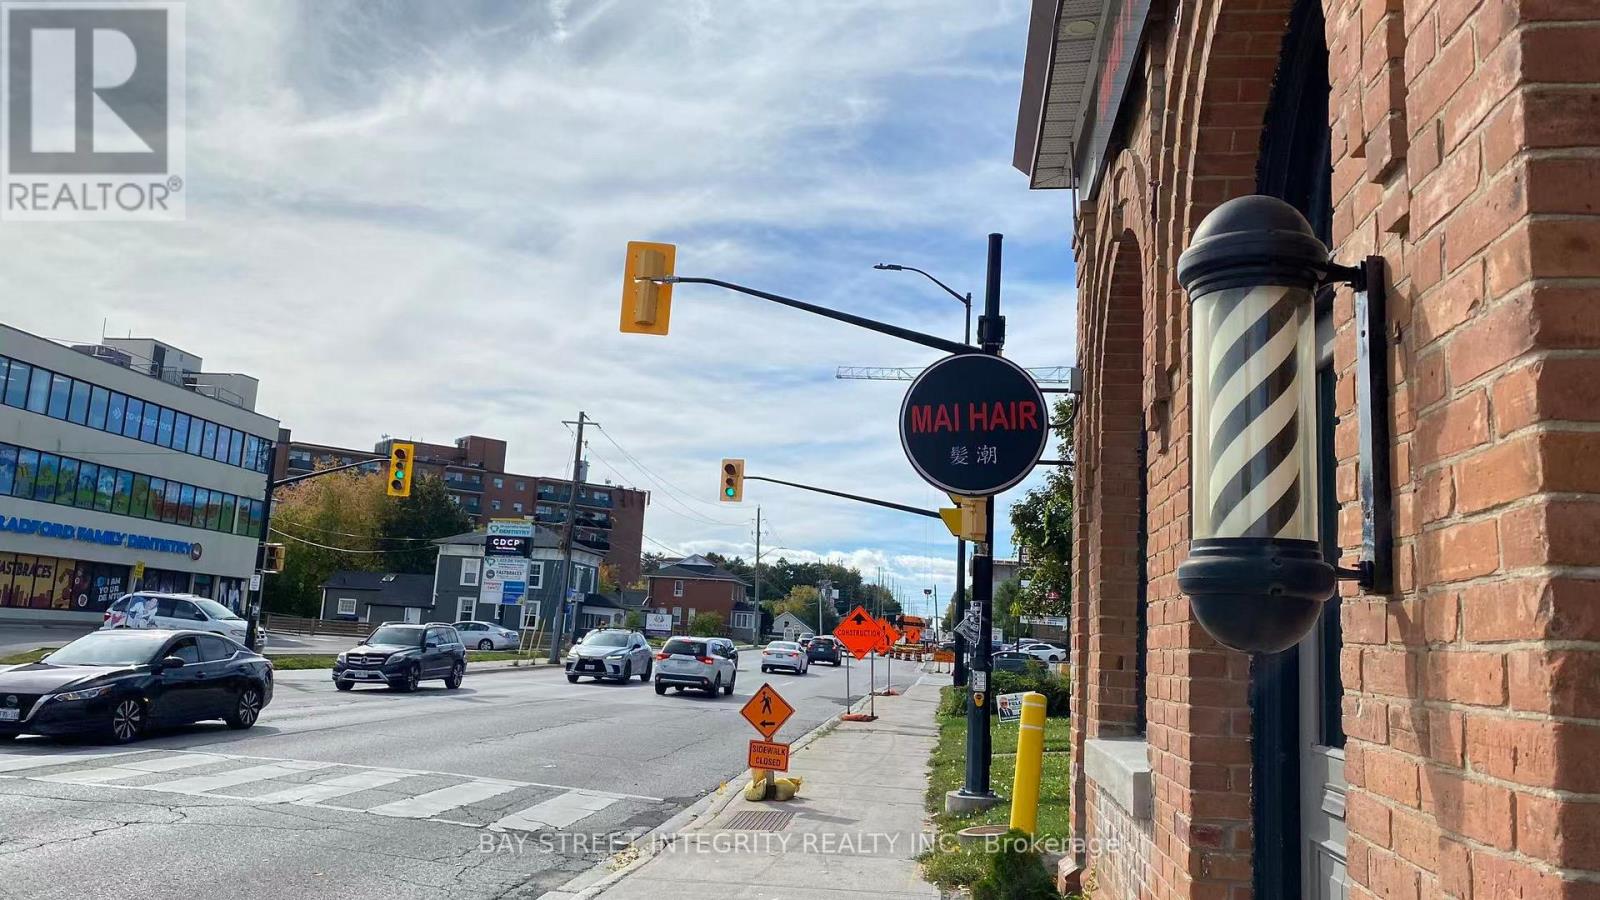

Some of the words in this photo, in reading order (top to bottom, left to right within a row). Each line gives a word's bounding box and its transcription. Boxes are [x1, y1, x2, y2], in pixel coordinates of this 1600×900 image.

[911, 403, 960, 433] MAI
[969, 401, 1038, 431] HAIR
[493, 538, 521, 546] CDCP
[837, 629, 882, 638] CONSTRUCTION
[752, 744, 786, 757] SIDEWALK
[755, 757, 781, 768] CLOSED
